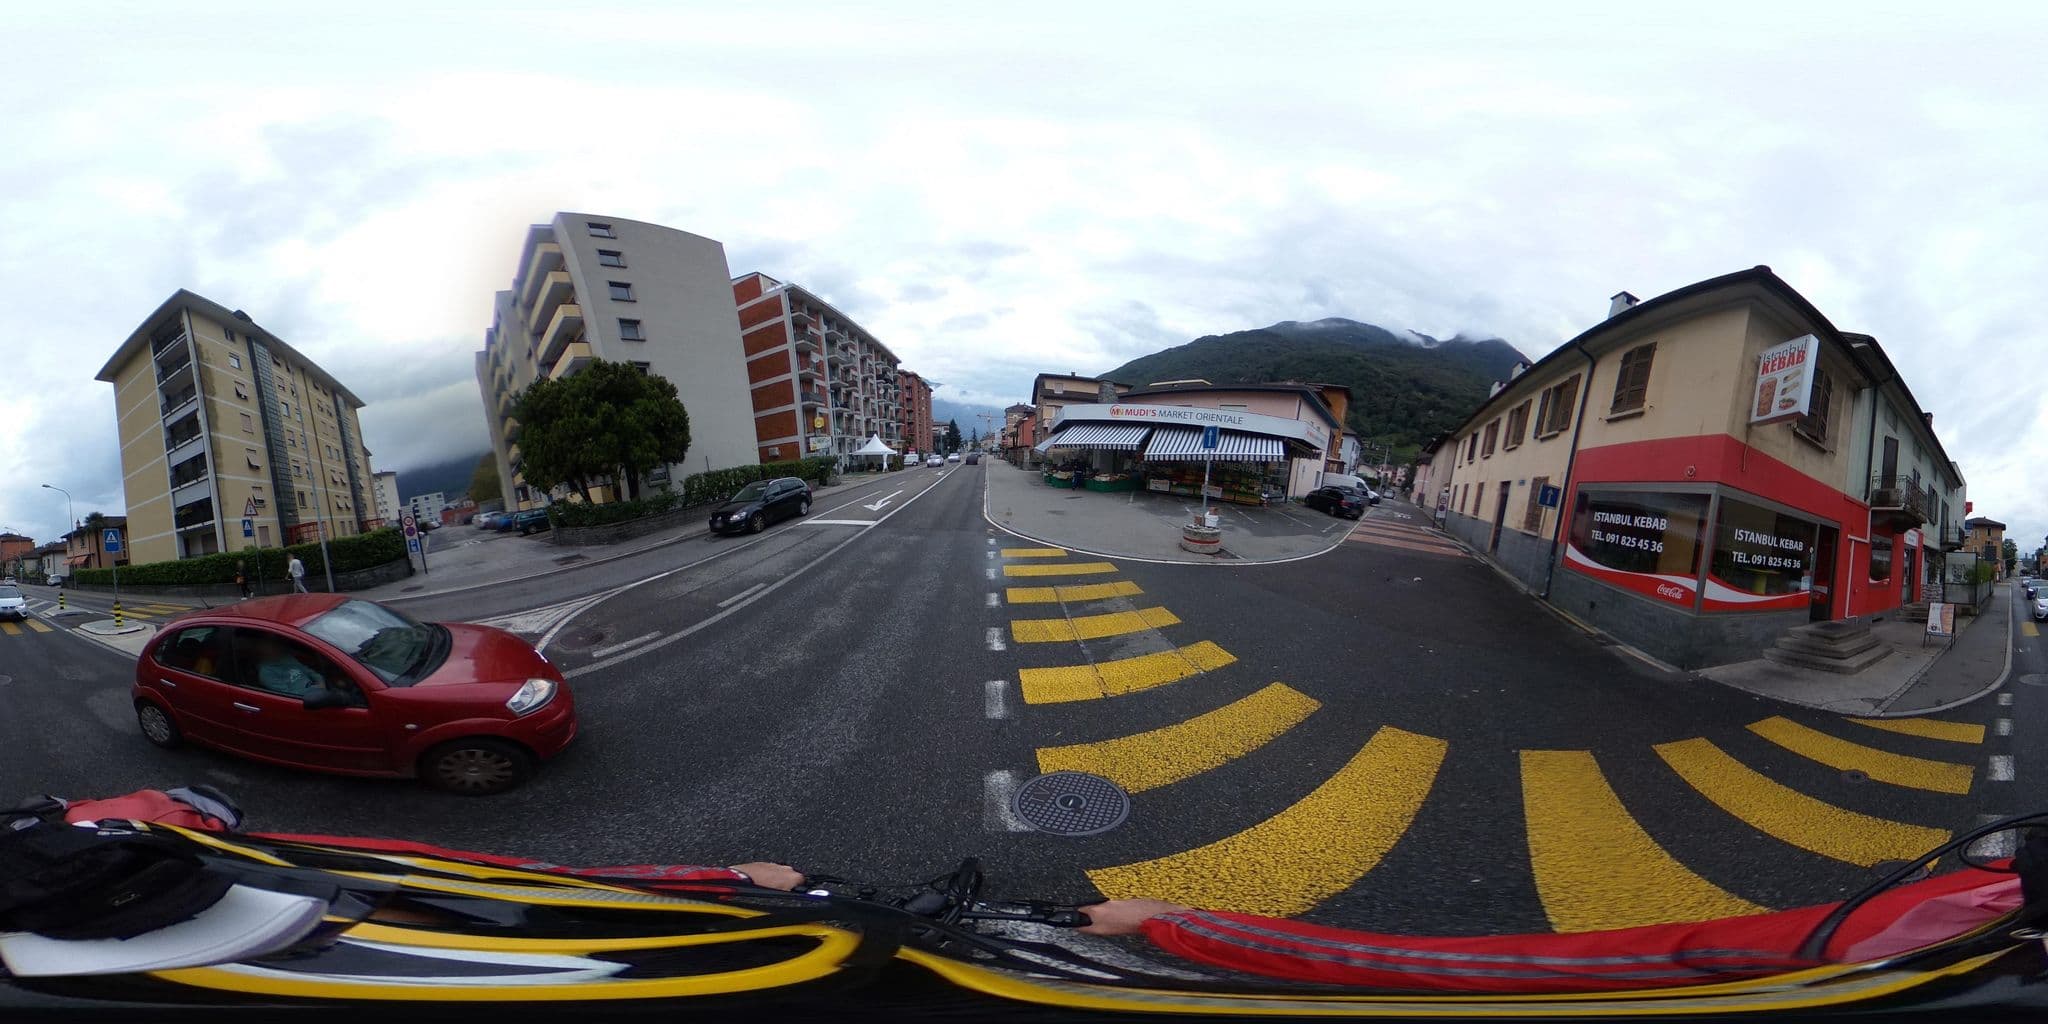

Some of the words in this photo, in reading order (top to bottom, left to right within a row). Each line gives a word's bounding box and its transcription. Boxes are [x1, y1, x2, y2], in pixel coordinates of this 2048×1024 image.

[1763, 338, 1808, 363] Istanbul
[1761, 350, 1806, 375] KEBAB
[1125, 409, 1156, 417] MUDI'S
[1158, 410, 1193, 420] MARKET
[1196, 413, 1243, 425] ORIENTALE
[1593, 511, 1632, 526] ISTANBUL
[1633, 517, 1667, 530] KEBAB
[1591, 530, 1605, 541] TEL.
[1605, 533, 1620, 544] 091
[1621, 536, 1636, 548] 825
[1637, 539, 1650, 551] 45
[1650, 541, 1664, 553] 36
[1734, 528, 1779, 548] ISTANBUL
[1780, 537, 1804, 552] KEBAB
[1732, 551, 1750, 564] TEL.
[1751, 554, 1766, 566] 091
[1768, 555, 1782, 568] 825
[1782, 557, 1792, 569] 45
[1792, 559, 1801, 569] 36
